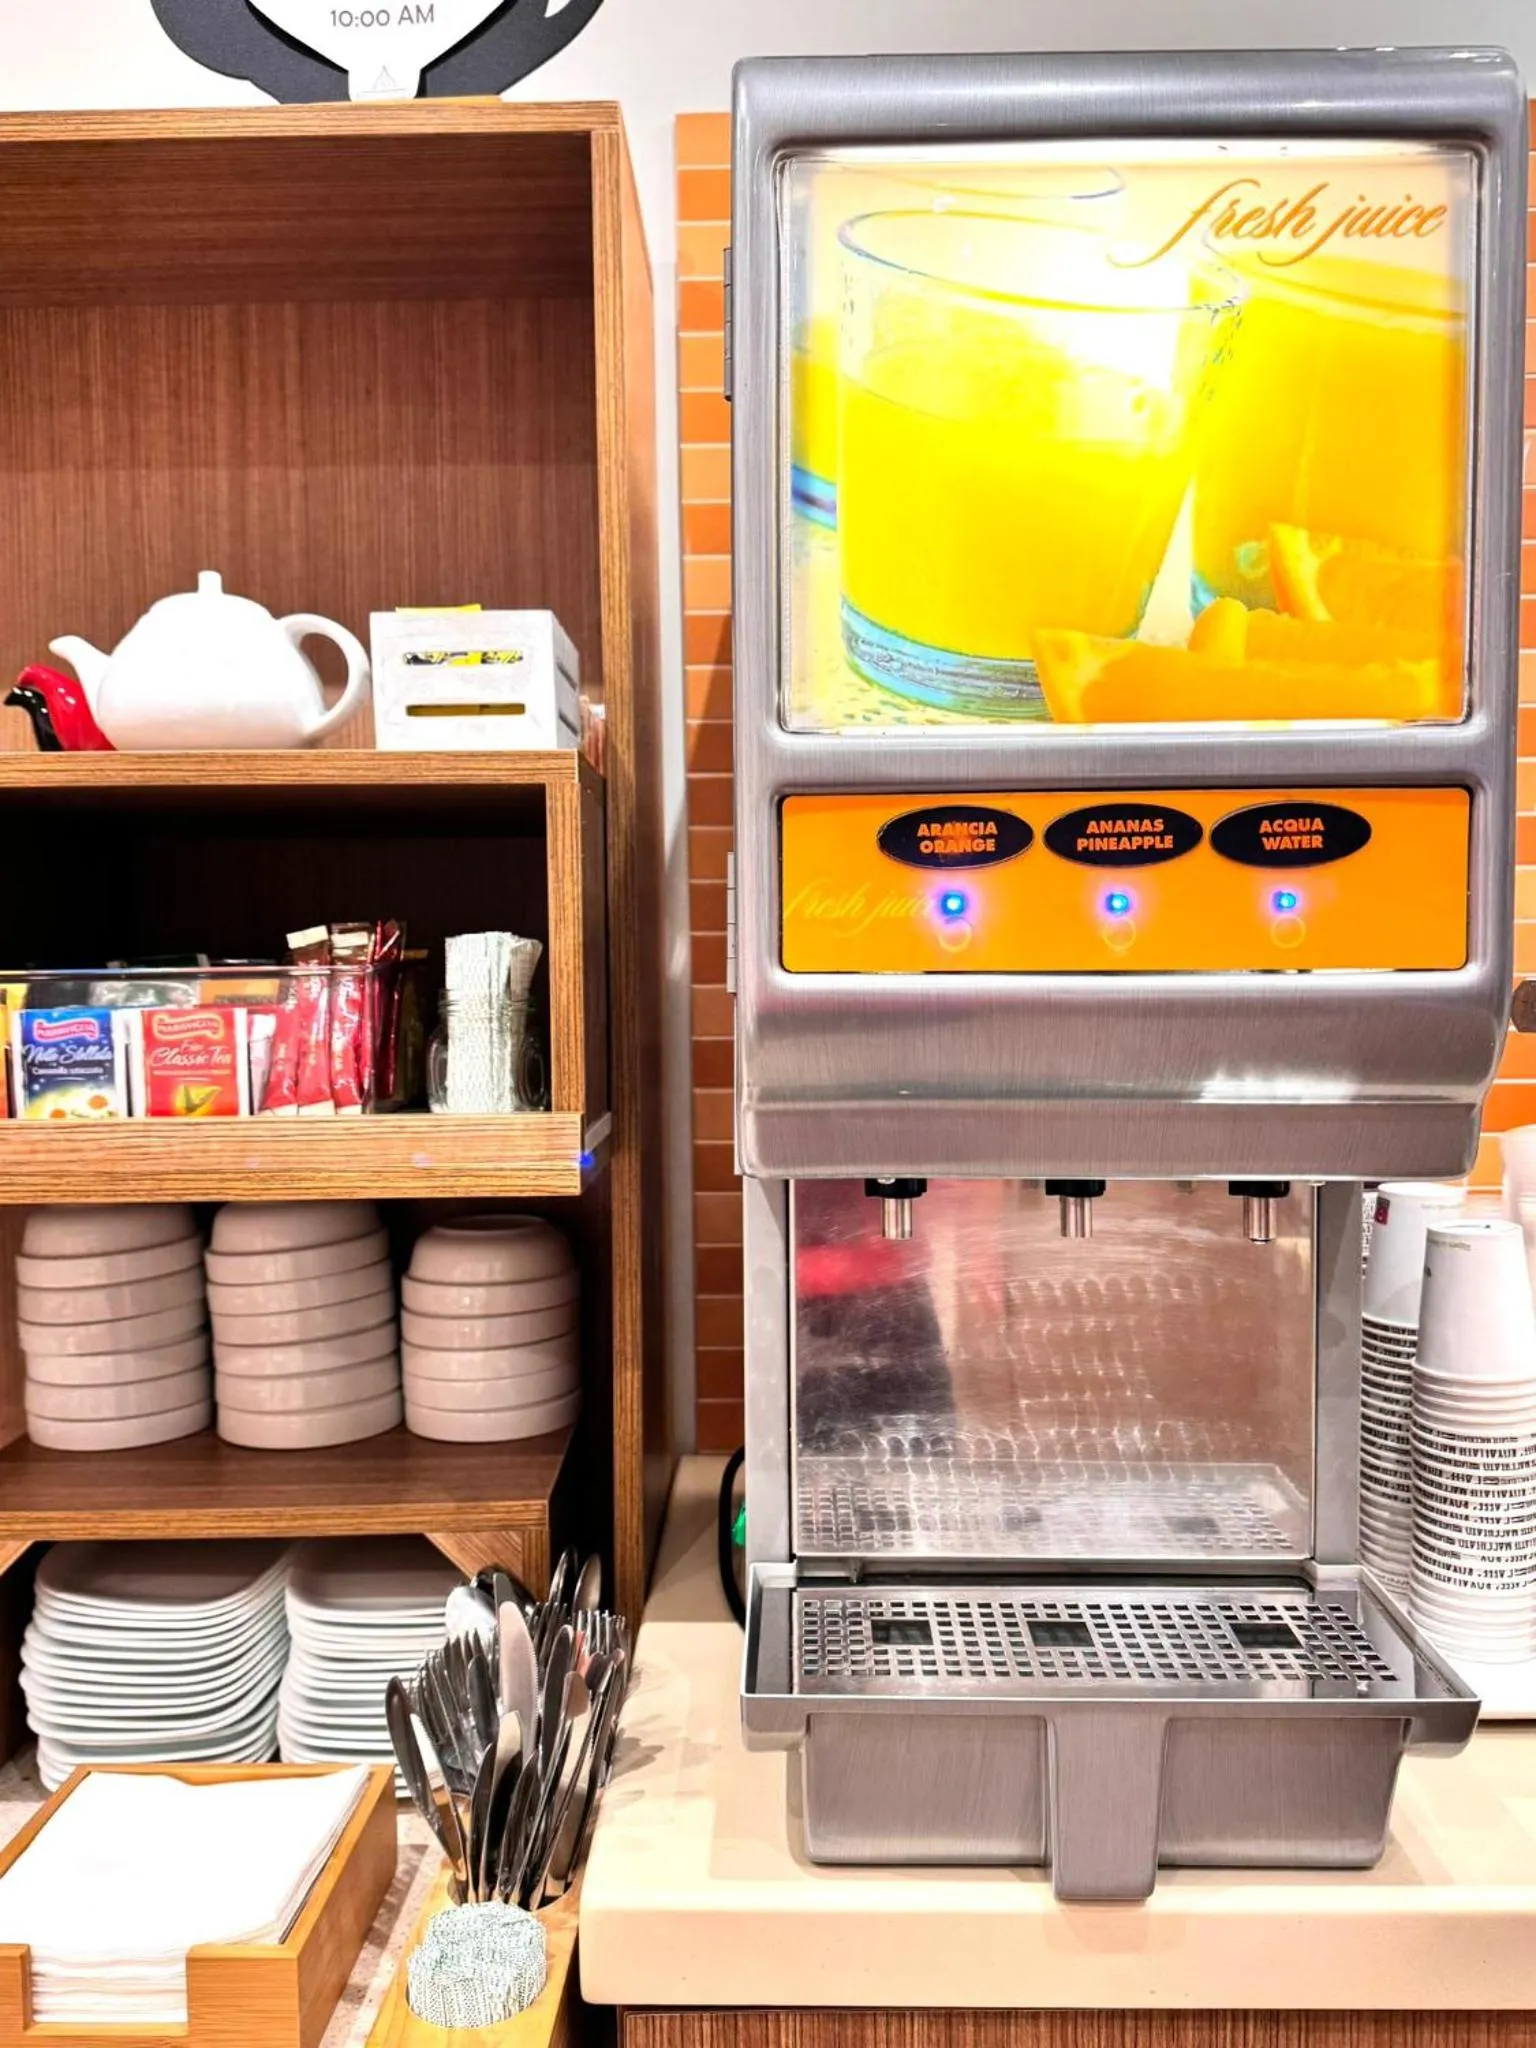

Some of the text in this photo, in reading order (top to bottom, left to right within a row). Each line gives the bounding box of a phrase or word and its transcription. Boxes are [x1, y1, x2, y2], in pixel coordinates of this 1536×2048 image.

[330, 3, 434, 28] 10:00 AM
[1107, 178, 1448, 268] fresh juice
[917, 821, 998, 836] ARANCIA
[1086, 818, 1165, 834] ANANAS
[1259, 817, 1325, 834] ACQUA
[919, 838, 996, 854] ORANGE
[1076, 835, 1174, 851] PINEAPPLE
[1261, 835, 1324, 851] WATER
